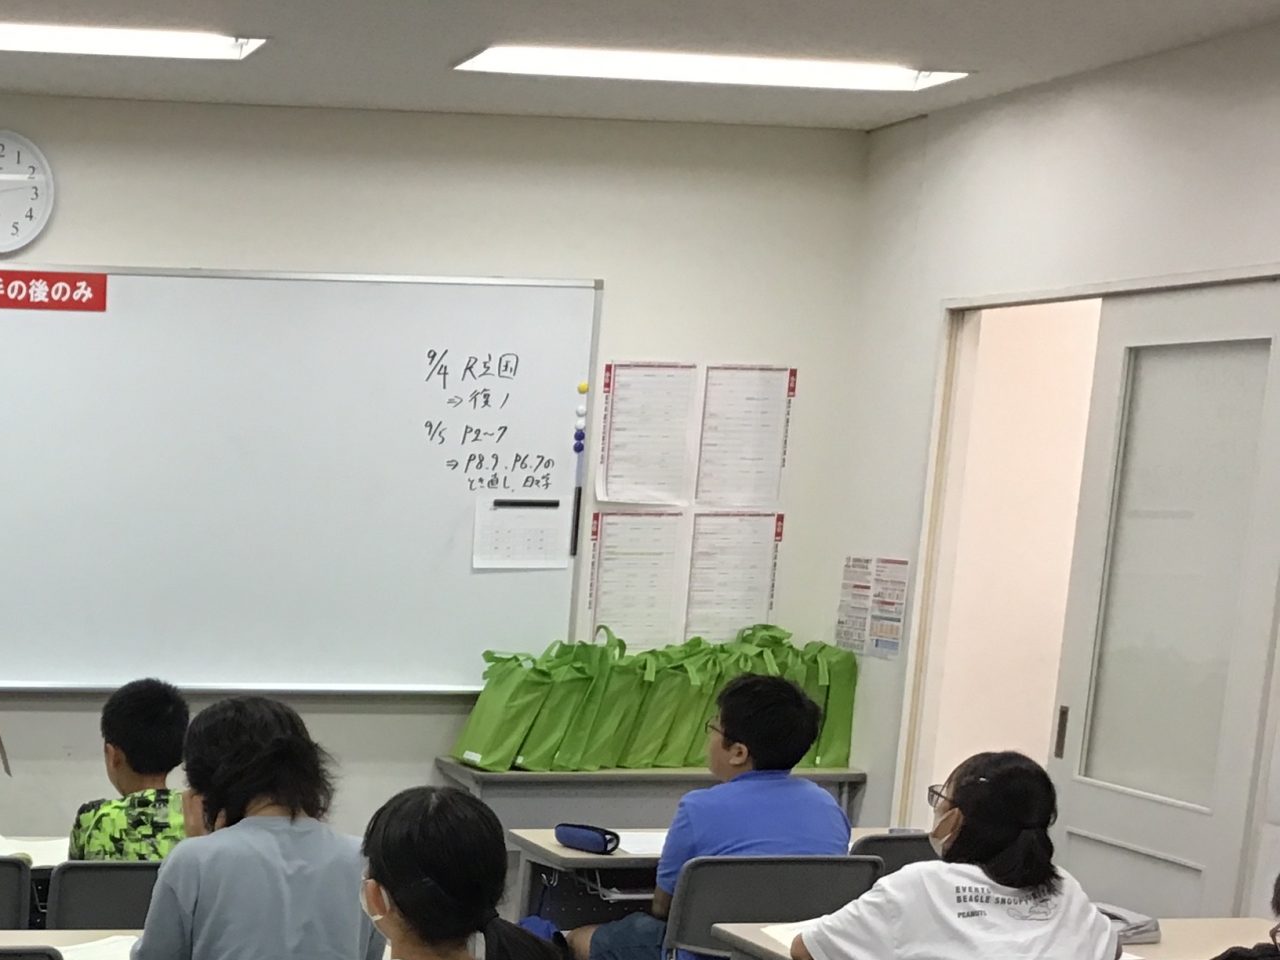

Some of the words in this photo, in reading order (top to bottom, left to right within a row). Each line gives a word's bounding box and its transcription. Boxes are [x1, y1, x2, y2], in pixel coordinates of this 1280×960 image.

[15, 150, 21, 165] 1
[27, 166, 36, 180] 2
[30, 186, 39, 200] 3
[24, 208, 34, 221] 4
[11, 222, 20, 236] 5
[956, 895, 990, 904] BEAGLE
